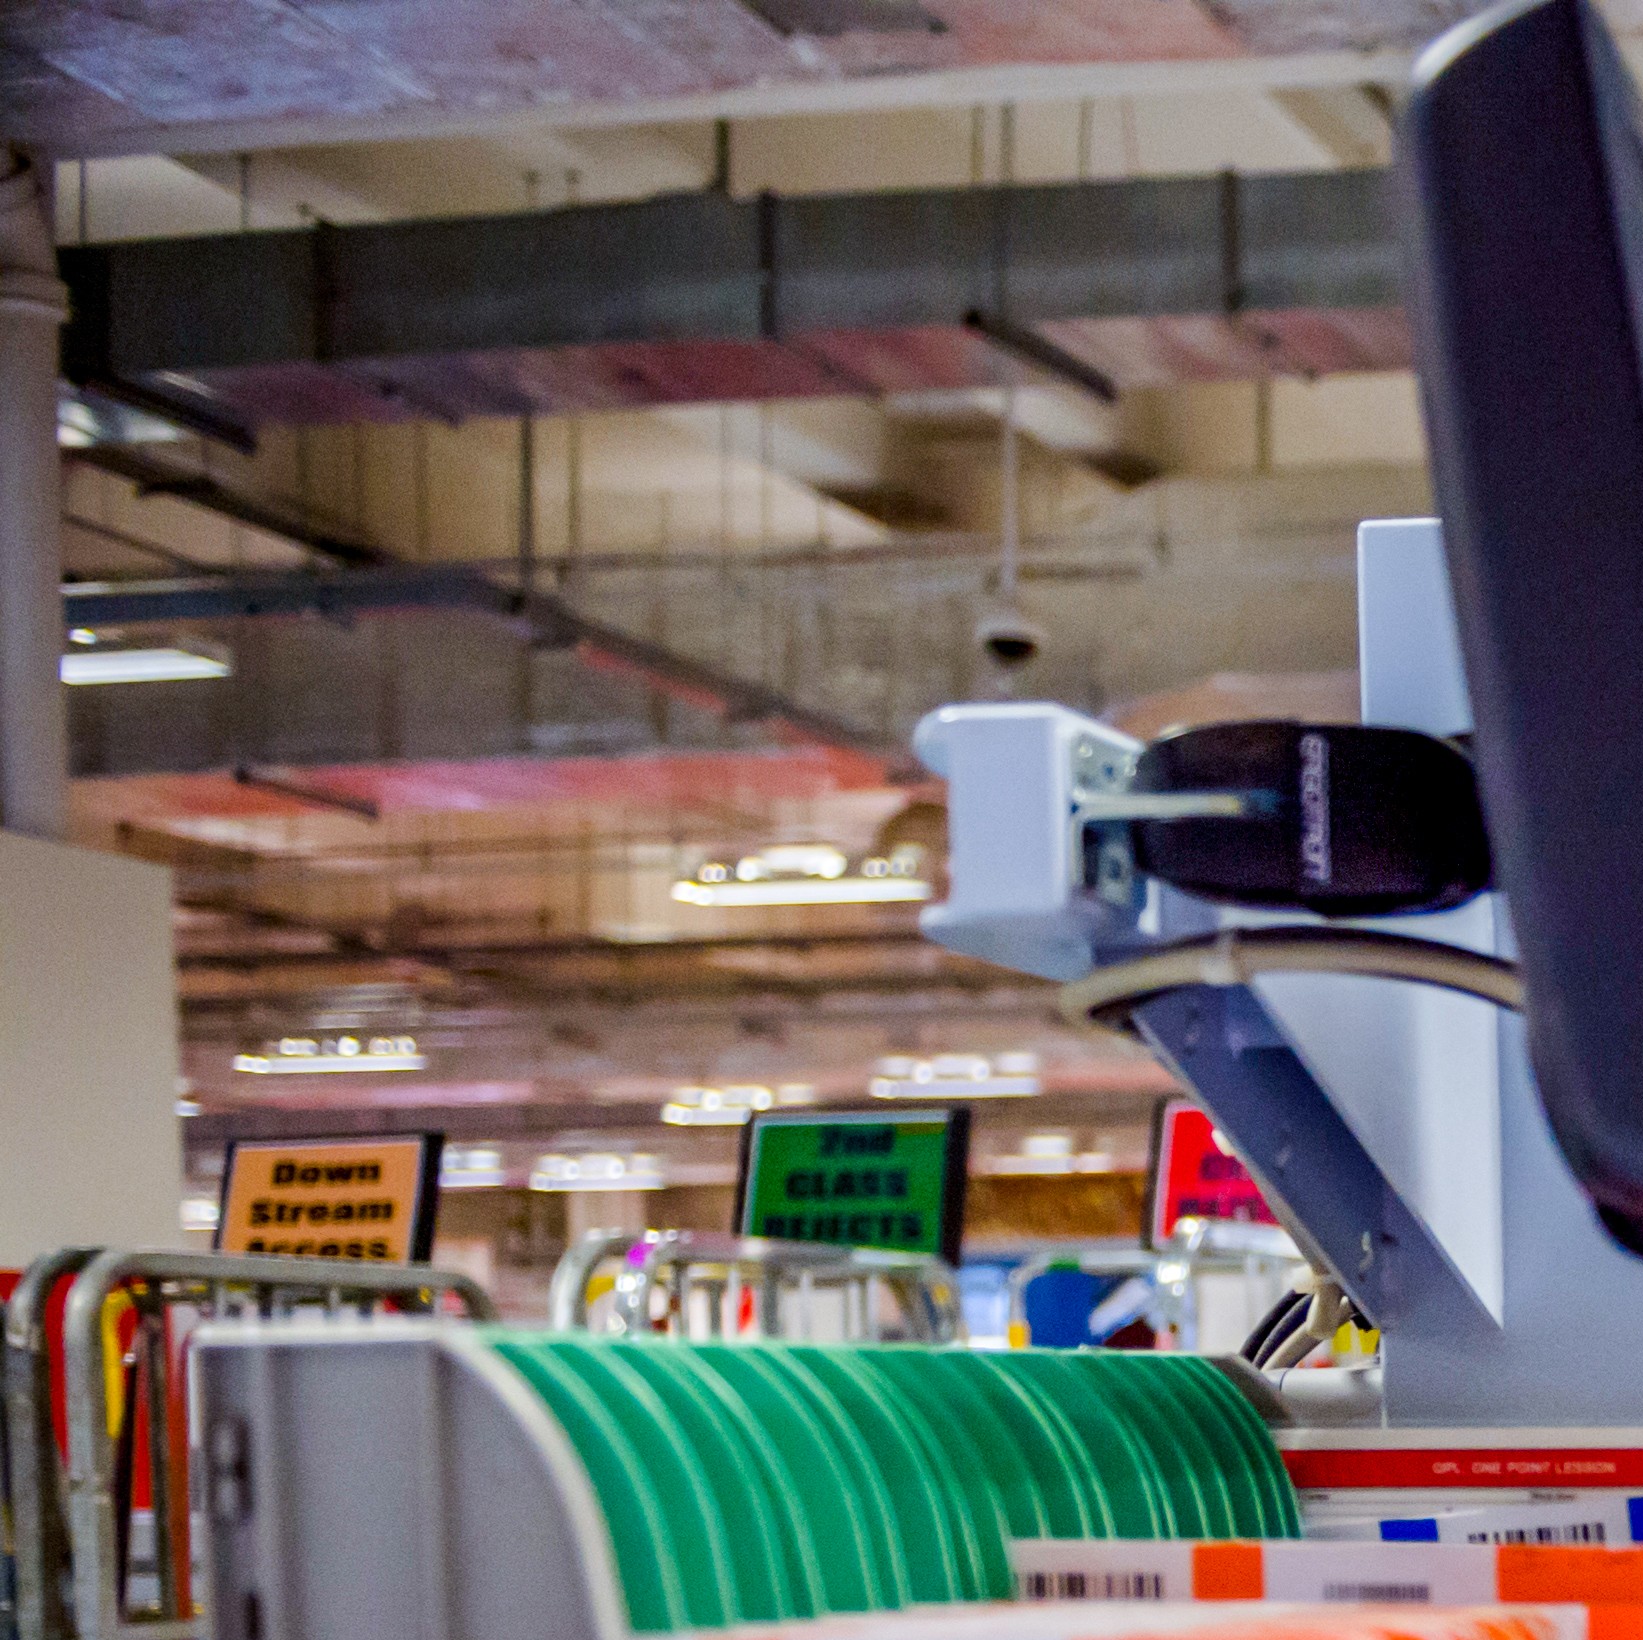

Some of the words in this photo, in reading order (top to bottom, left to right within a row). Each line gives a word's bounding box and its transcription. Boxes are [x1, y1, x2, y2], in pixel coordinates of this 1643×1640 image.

[273, 1162, 381, 1185] Down
[786, 1171, 908, 1198] CLASS
[251, 1201, 393, 1224] Stream
[1471, 1461, 1502, 1475] ONE
[1506, 1461, 1551, 1475] POINT
[1554, 1461, 1617, 1475] LESSON
